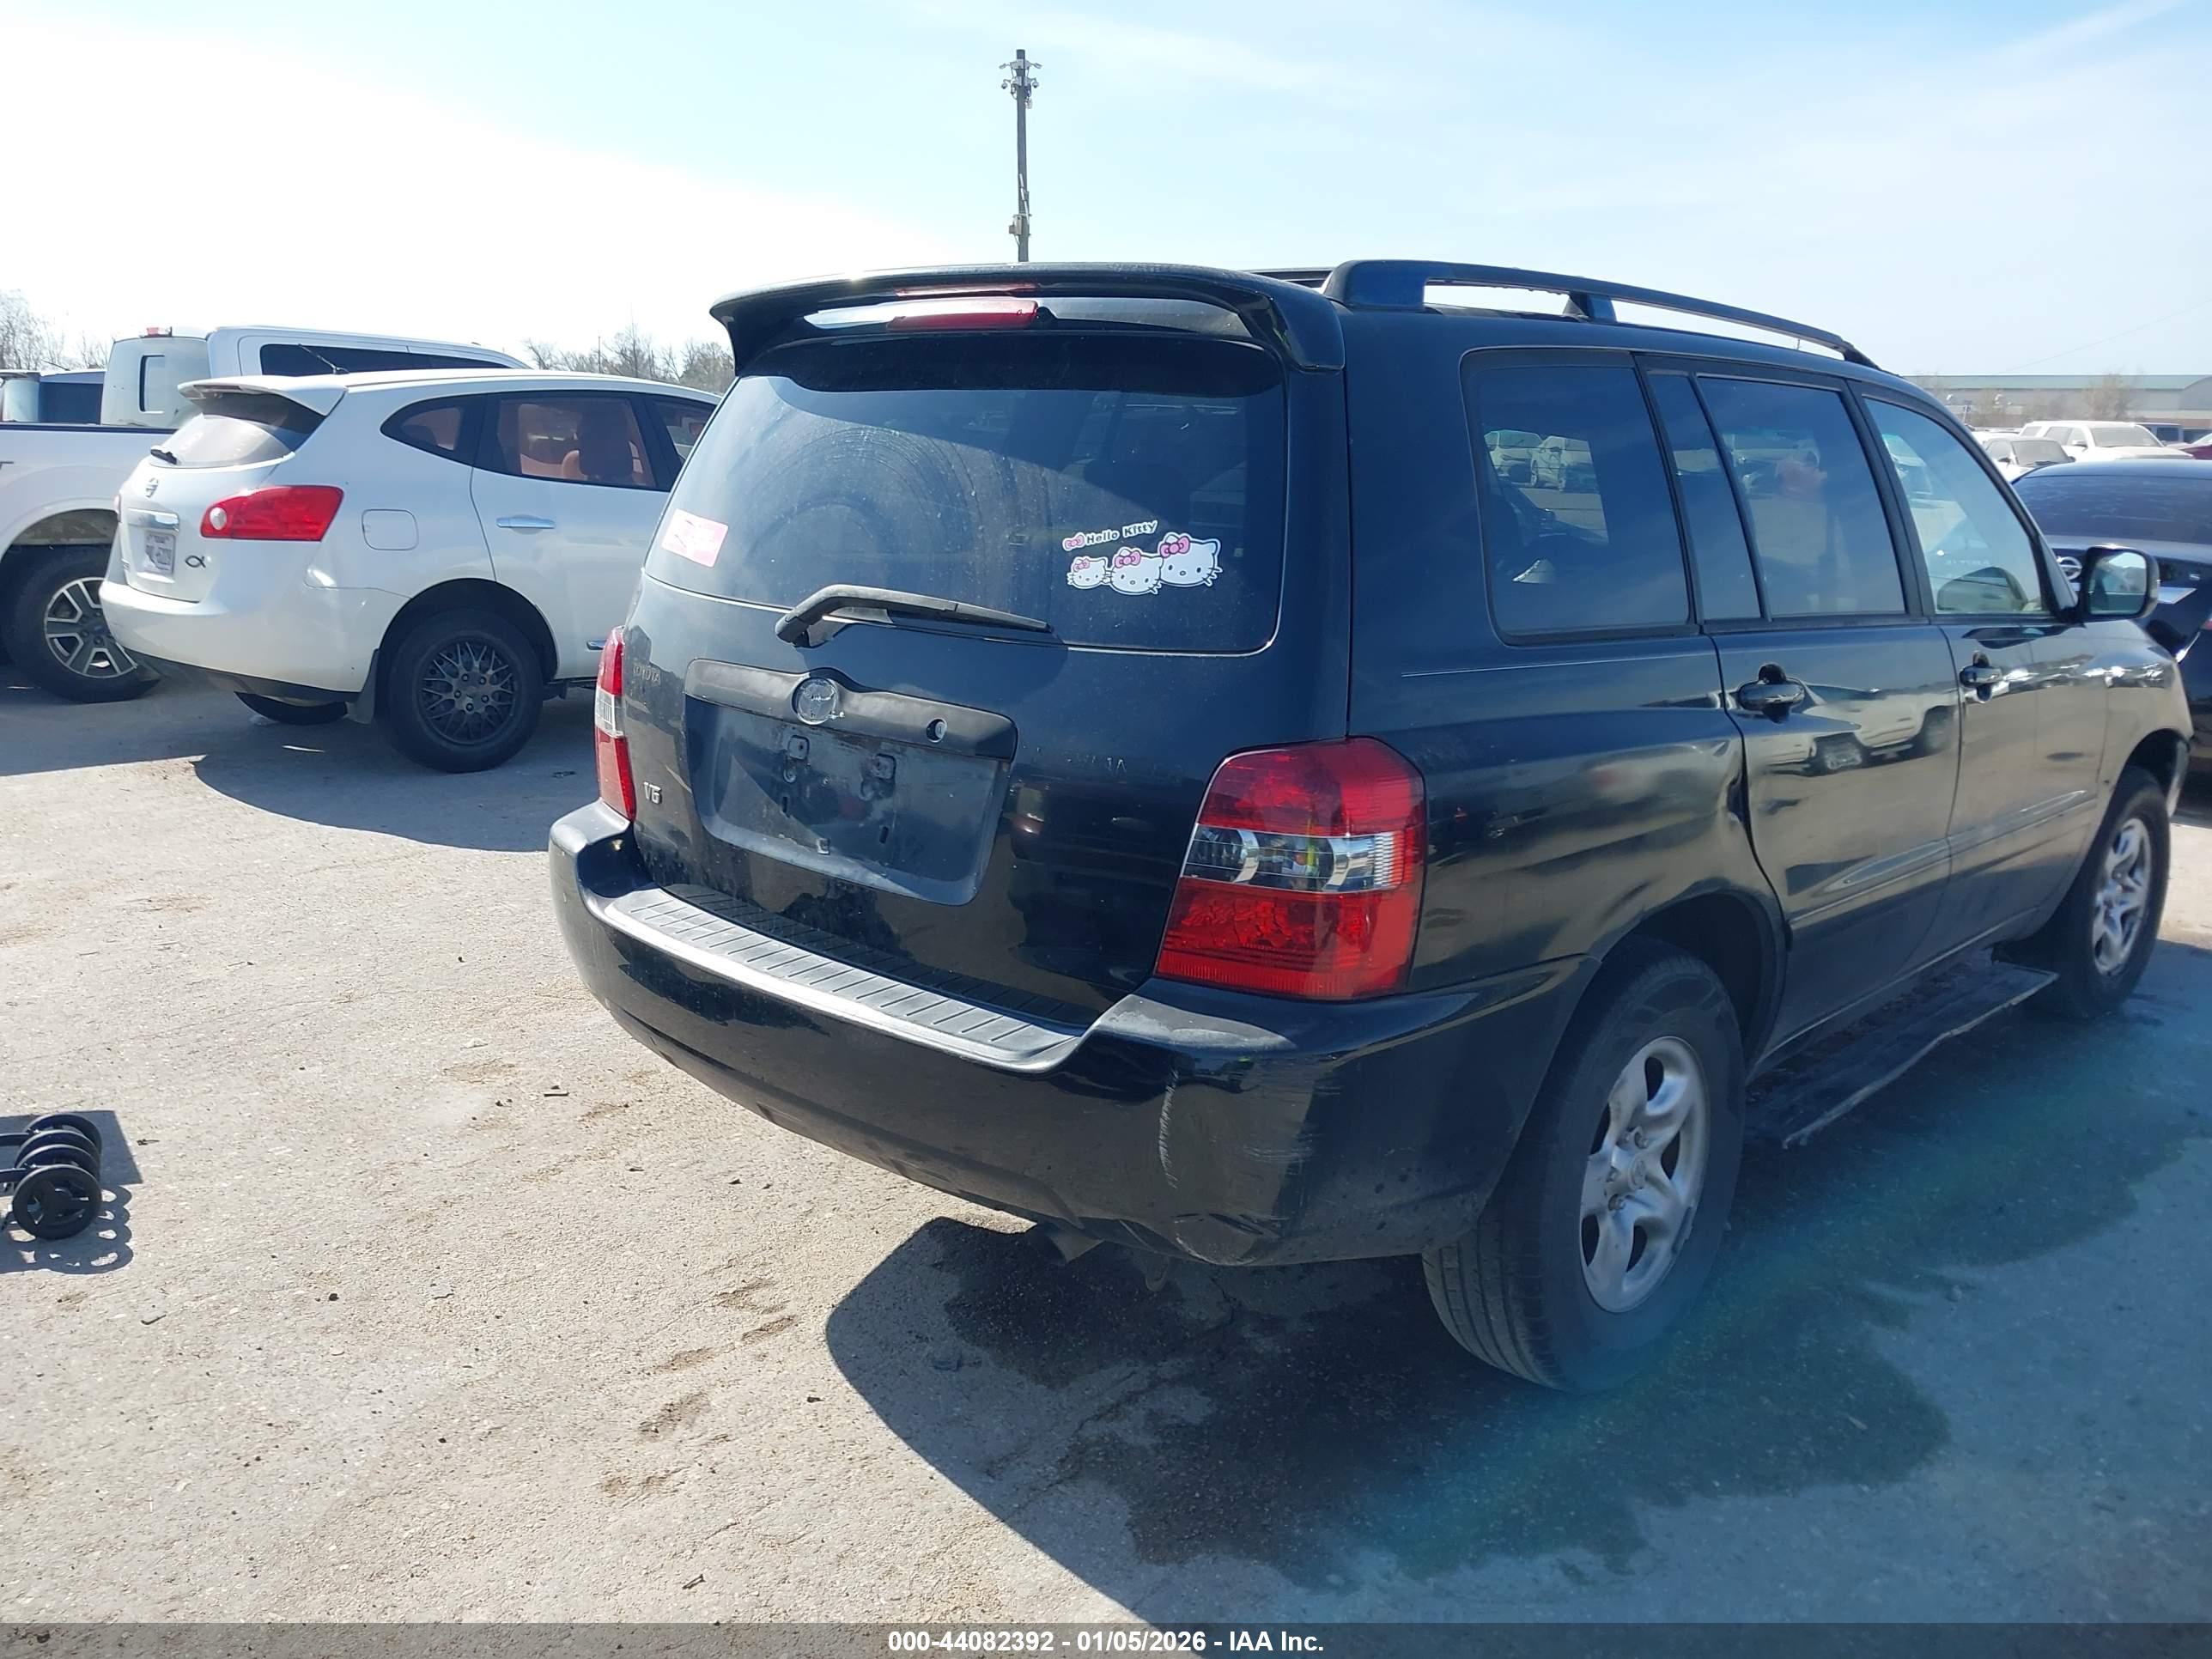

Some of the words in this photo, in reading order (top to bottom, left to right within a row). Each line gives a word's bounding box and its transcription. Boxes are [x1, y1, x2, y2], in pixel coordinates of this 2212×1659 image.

[1085, 532, 1120, 544] Hello
[1124, 520, 1157, 537] Kitty
[643, 781, 661, 804] V6
